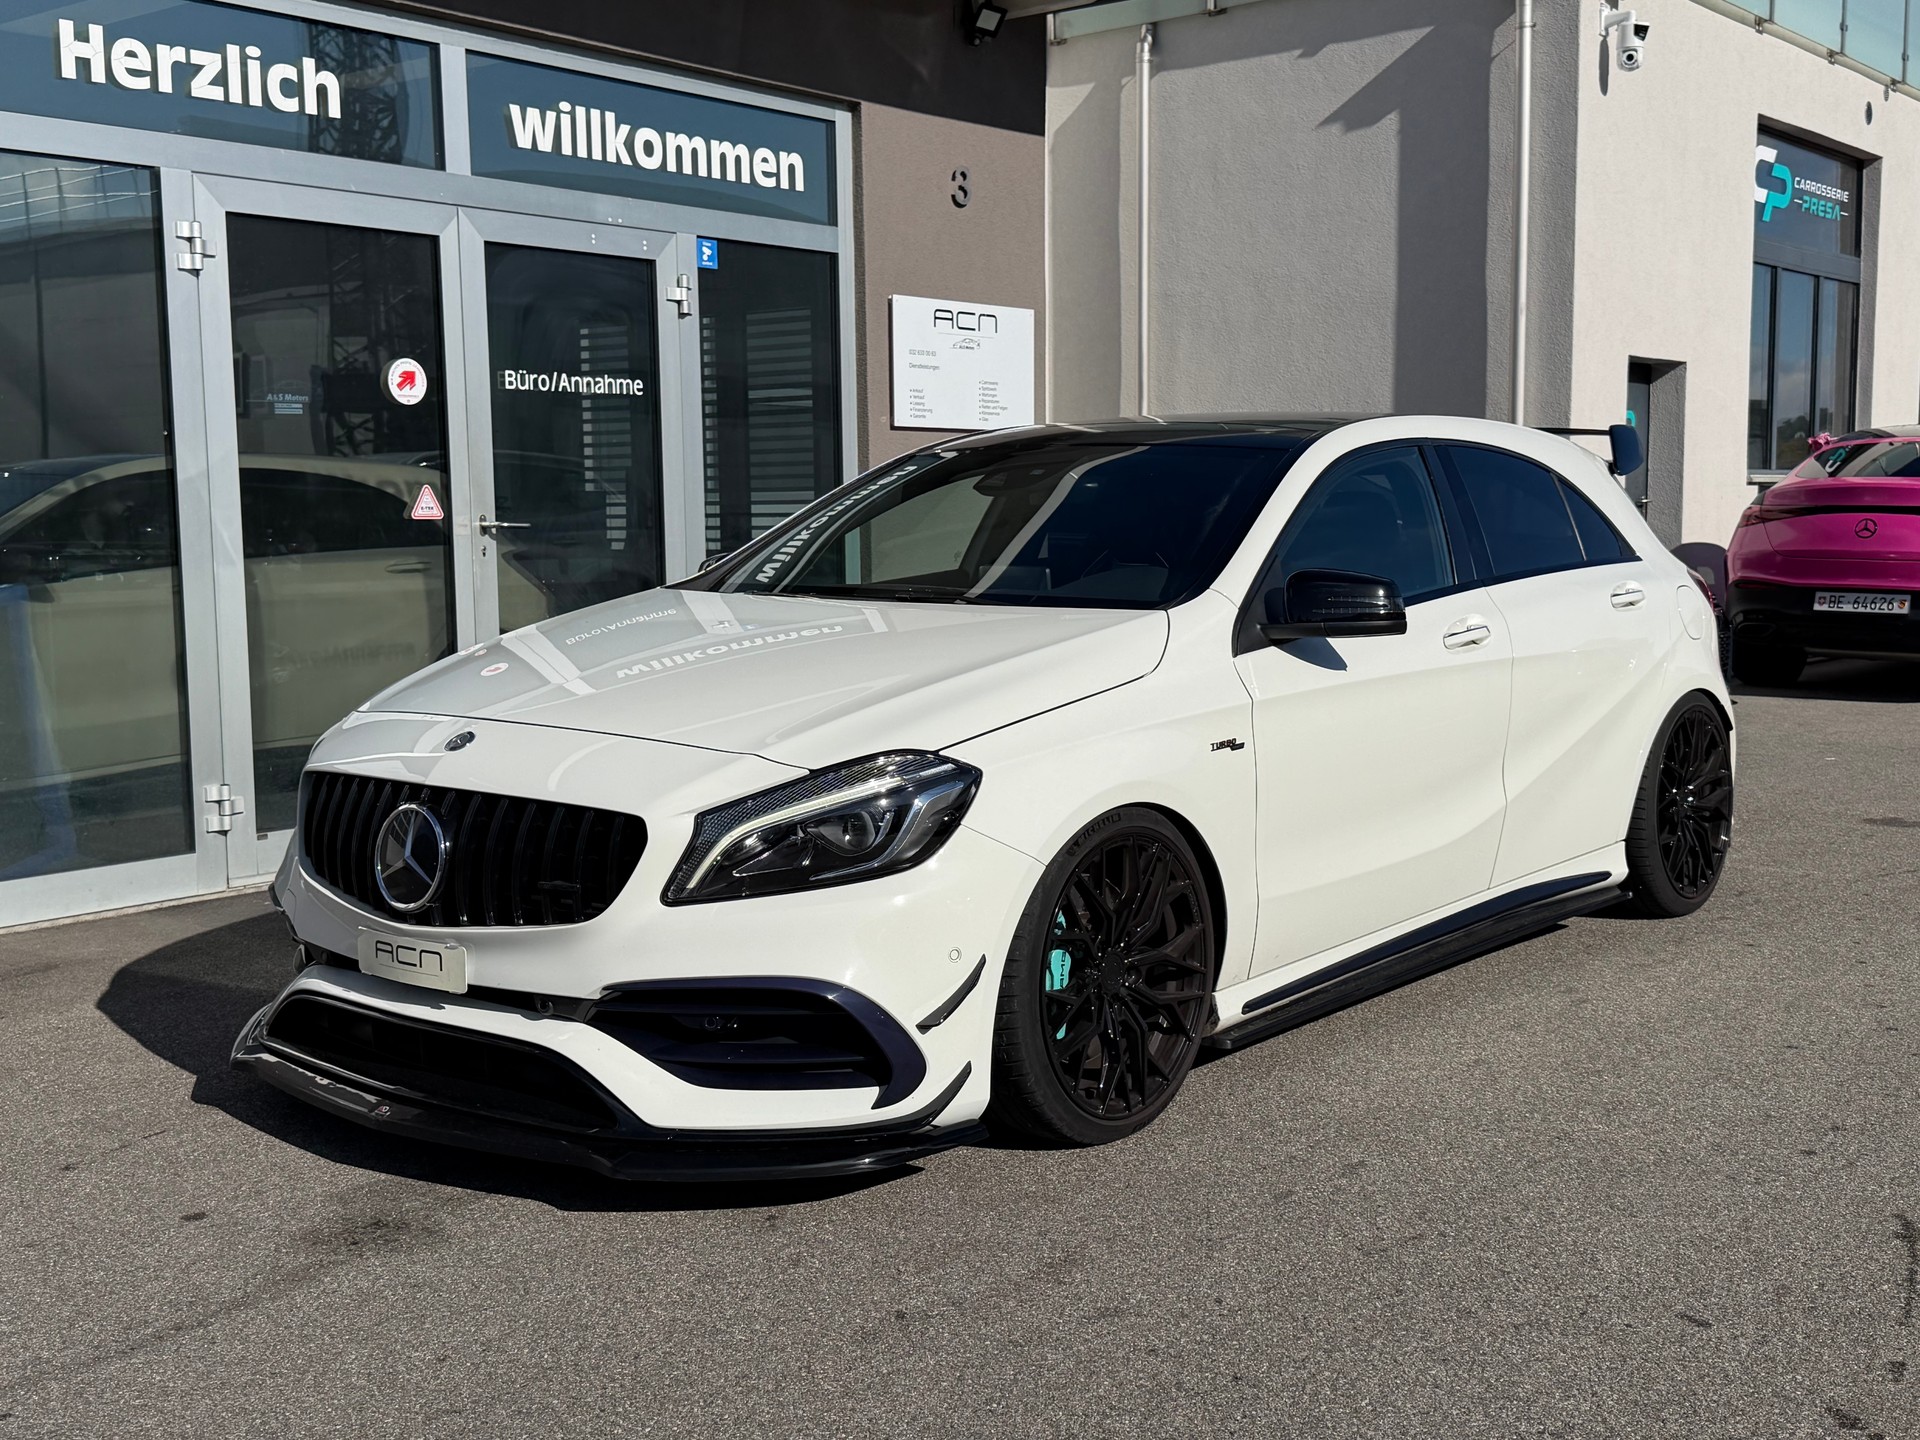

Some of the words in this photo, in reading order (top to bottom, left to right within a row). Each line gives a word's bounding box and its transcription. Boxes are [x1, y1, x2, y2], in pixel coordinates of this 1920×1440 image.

[58, 18, 341, 119] Herzlich
[509, 101, 805, 192] willkommen
[951, 166, 970, 208] 3
[1794, 177, 1849, 202] CARROSSERIE
[1801, 196, 1841, 221] PRESA
[504, 370, 643, 396] Büro/Annahme
[1828, 595, 1845, 609] BE
[1852, 596, 1895, 611] 64626
[1210, 738, 1237, 752] TURBO
